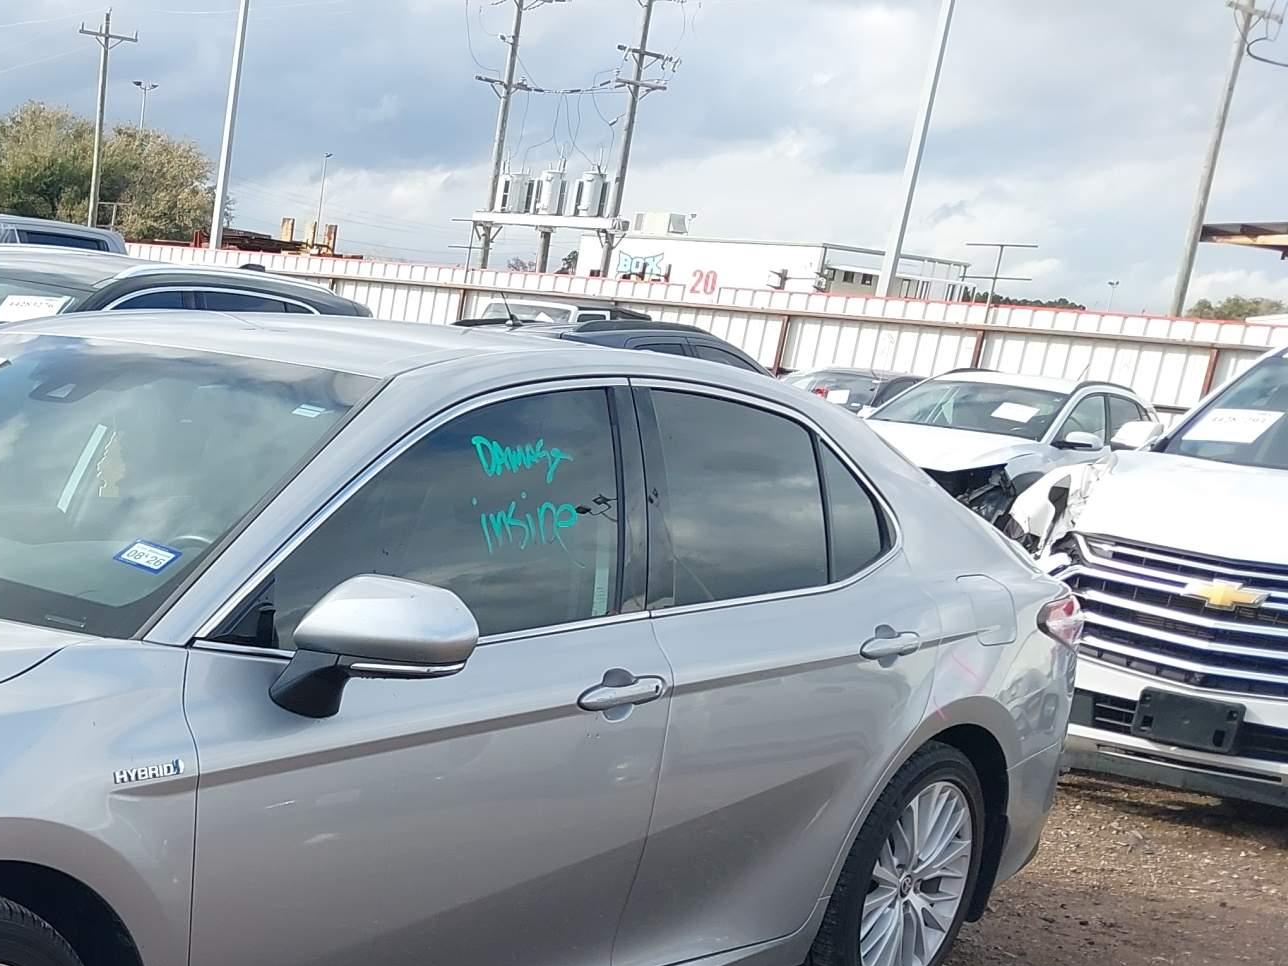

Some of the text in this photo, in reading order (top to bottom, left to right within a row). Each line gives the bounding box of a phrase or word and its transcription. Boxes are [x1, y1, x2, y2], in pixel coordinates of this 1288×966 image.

[616, 250, 664, 275] BOX
[690, 269, 718, 295] 20
[114, 763, 174, 784] HYBRID
